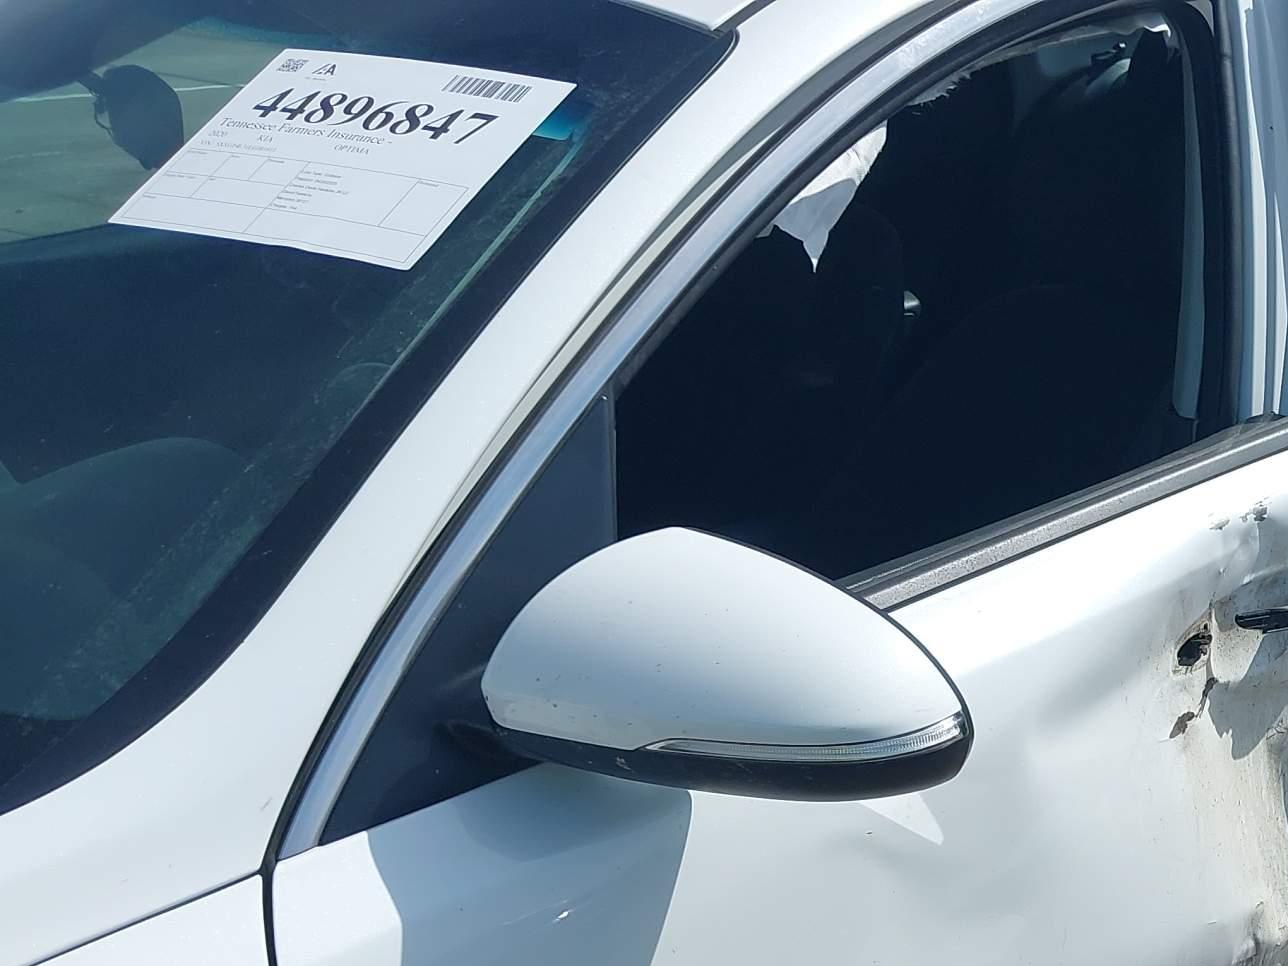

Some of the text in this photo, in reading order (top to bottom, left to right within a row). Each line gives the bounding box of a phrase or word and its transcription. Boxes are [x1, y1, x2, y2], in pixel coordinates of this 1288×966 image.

[219, 117, 277, 131] Tennessee
[278, 123, 325, 137] Farmers
[326, 129, 385, 145] Insurance
[252, 88, 500, 145] 44896847
